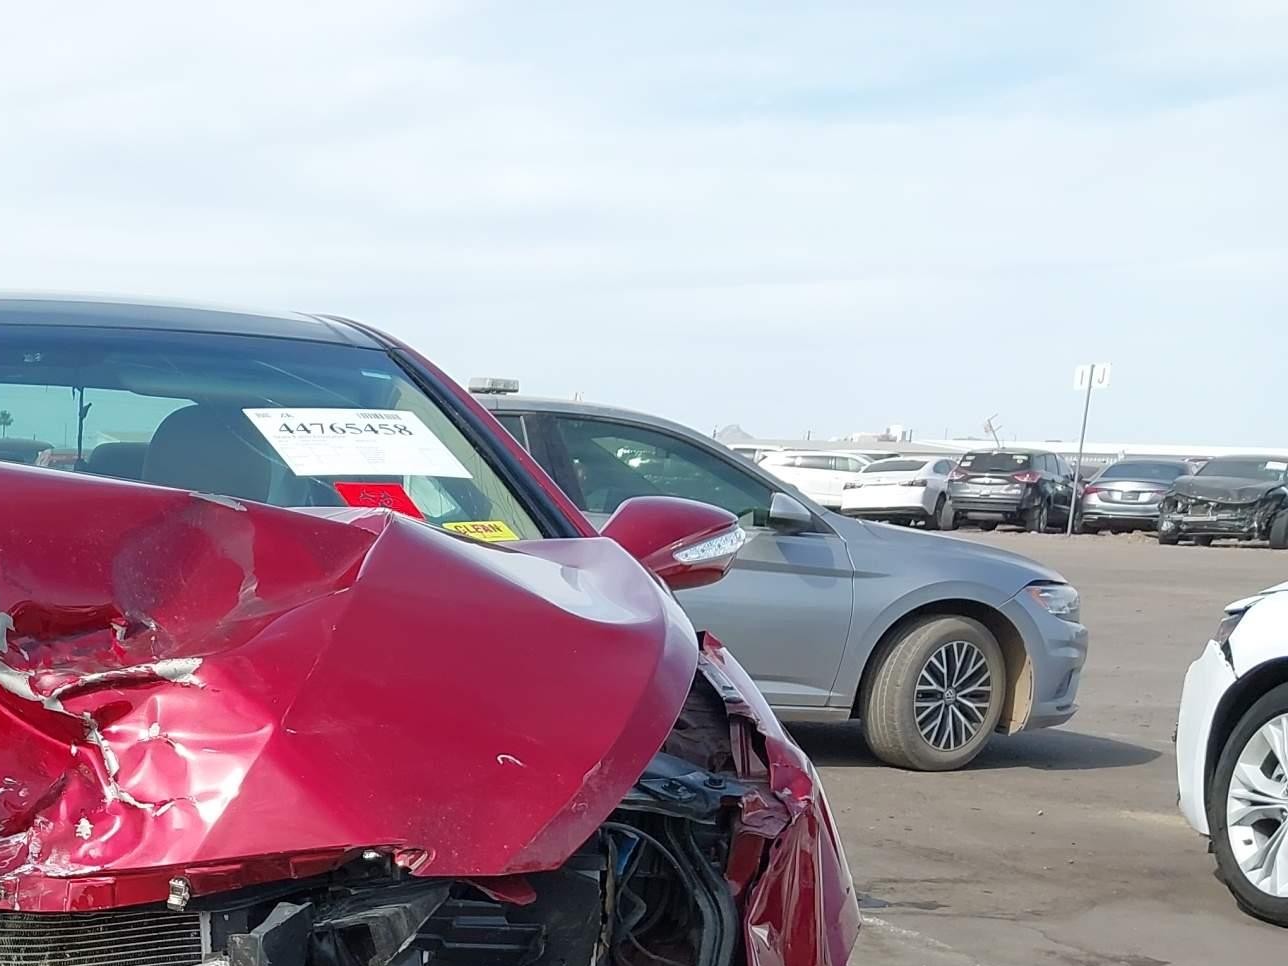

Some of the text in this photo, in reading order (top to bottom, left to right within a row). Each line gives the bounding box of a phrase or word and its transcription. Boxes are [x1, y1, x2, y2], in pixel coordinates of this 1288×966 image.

[1097, 367, 1106, 385] J
[279, 422, 414, 436] 44765458
[454, 523, 503, 535] CLEAN
